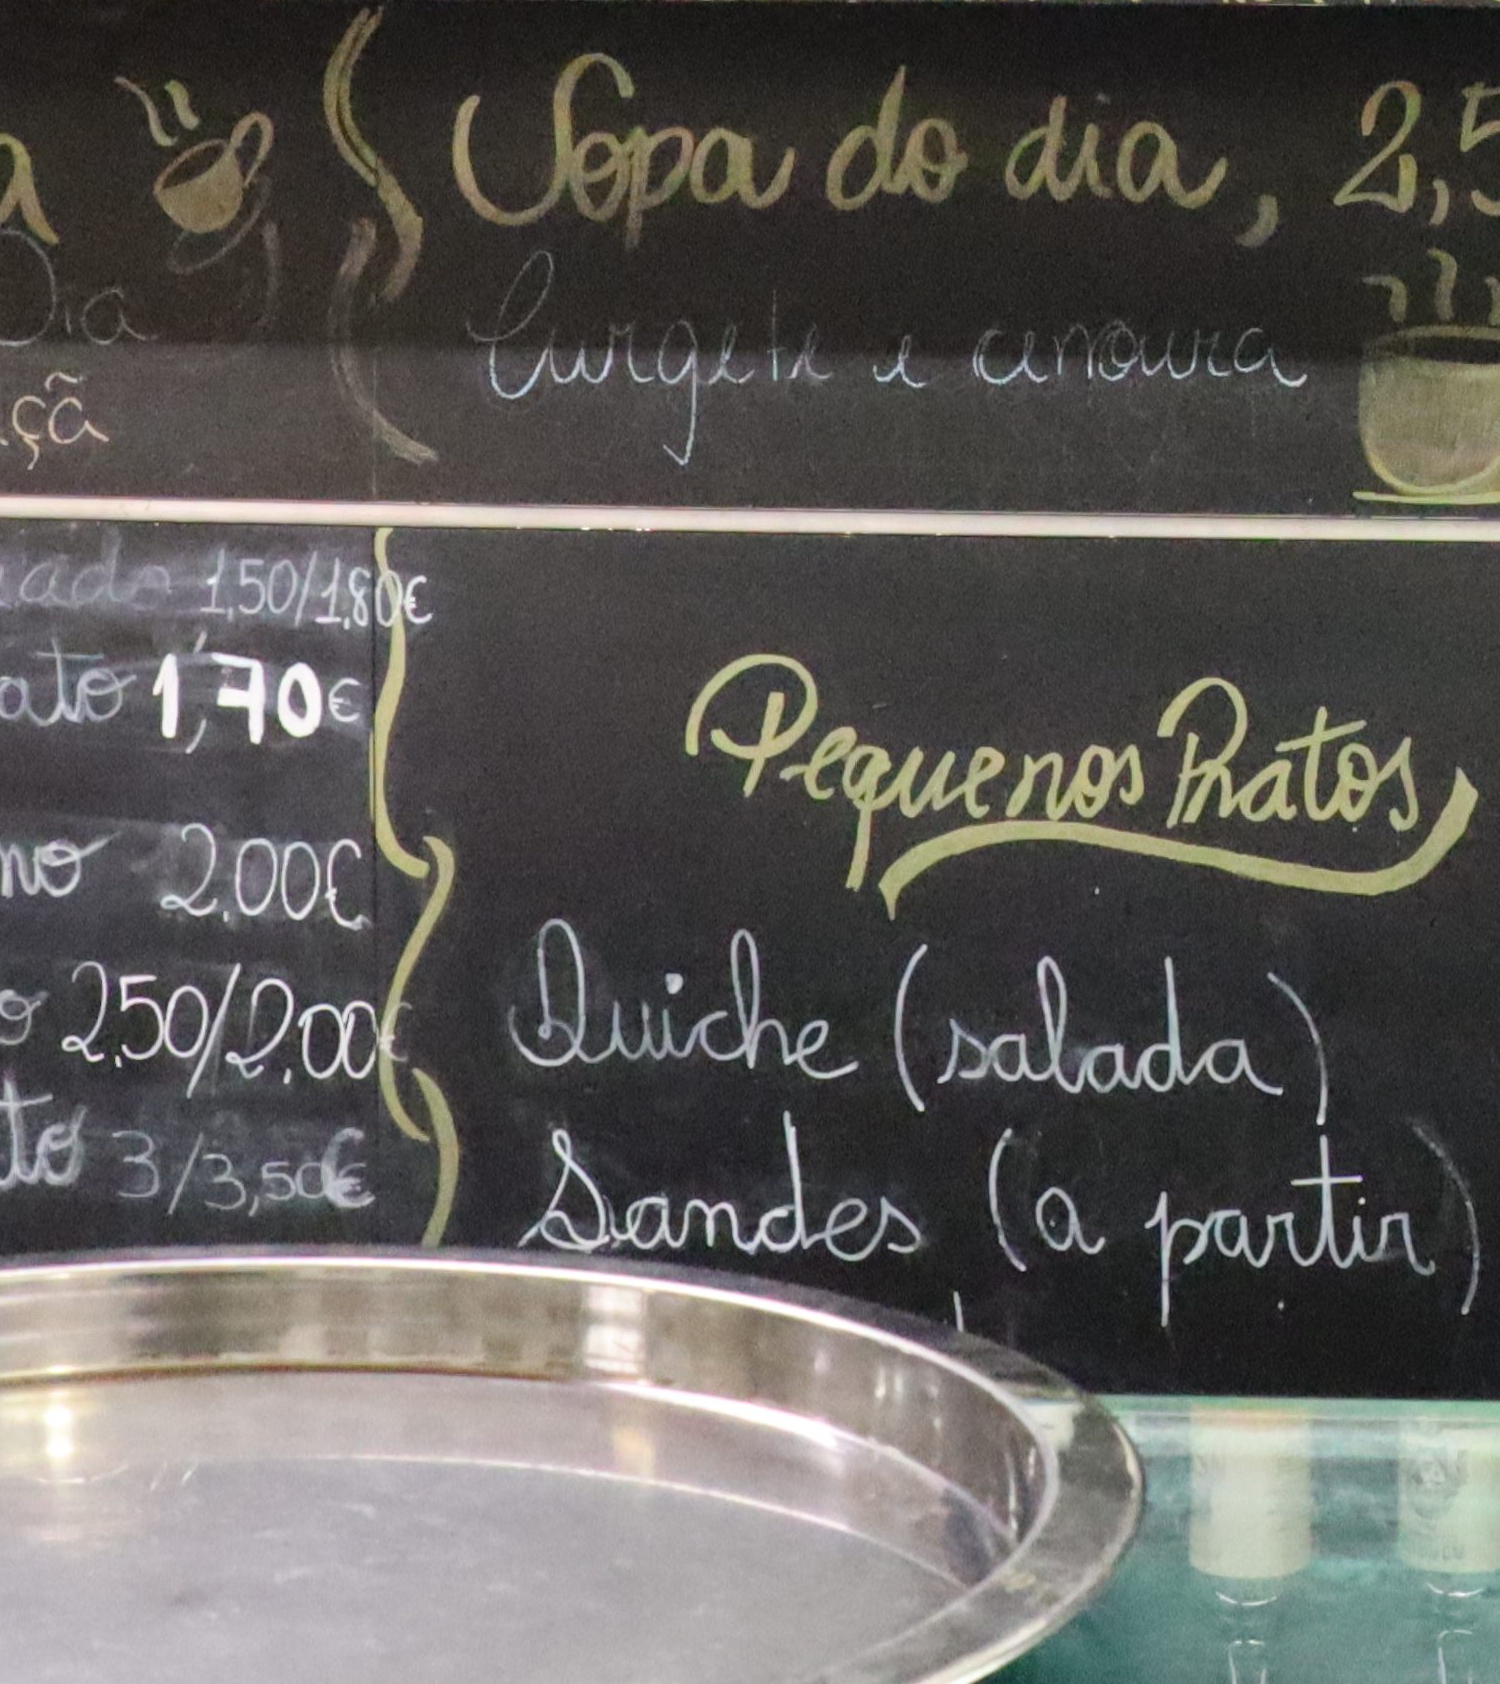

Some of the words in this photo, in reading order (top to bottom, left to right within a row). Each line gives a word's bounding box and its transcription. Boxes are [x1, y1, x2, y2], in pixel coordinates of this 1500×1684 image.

[453, 51, 797, 251] Sopa
[825, 66, 968, 211] do
[685, 654, 1143, 891] Pequenos
[1157, 677, 1415, 830] Pratos
[508, 918, 858, 1079] Quiche
[895, 944, 1328, 1126] (salada)
[518, 1111, 922, 1261] Sandes
[990, 1128, 1106, 1273] (a
[1145, 1119, 1481, 1328] partir)
